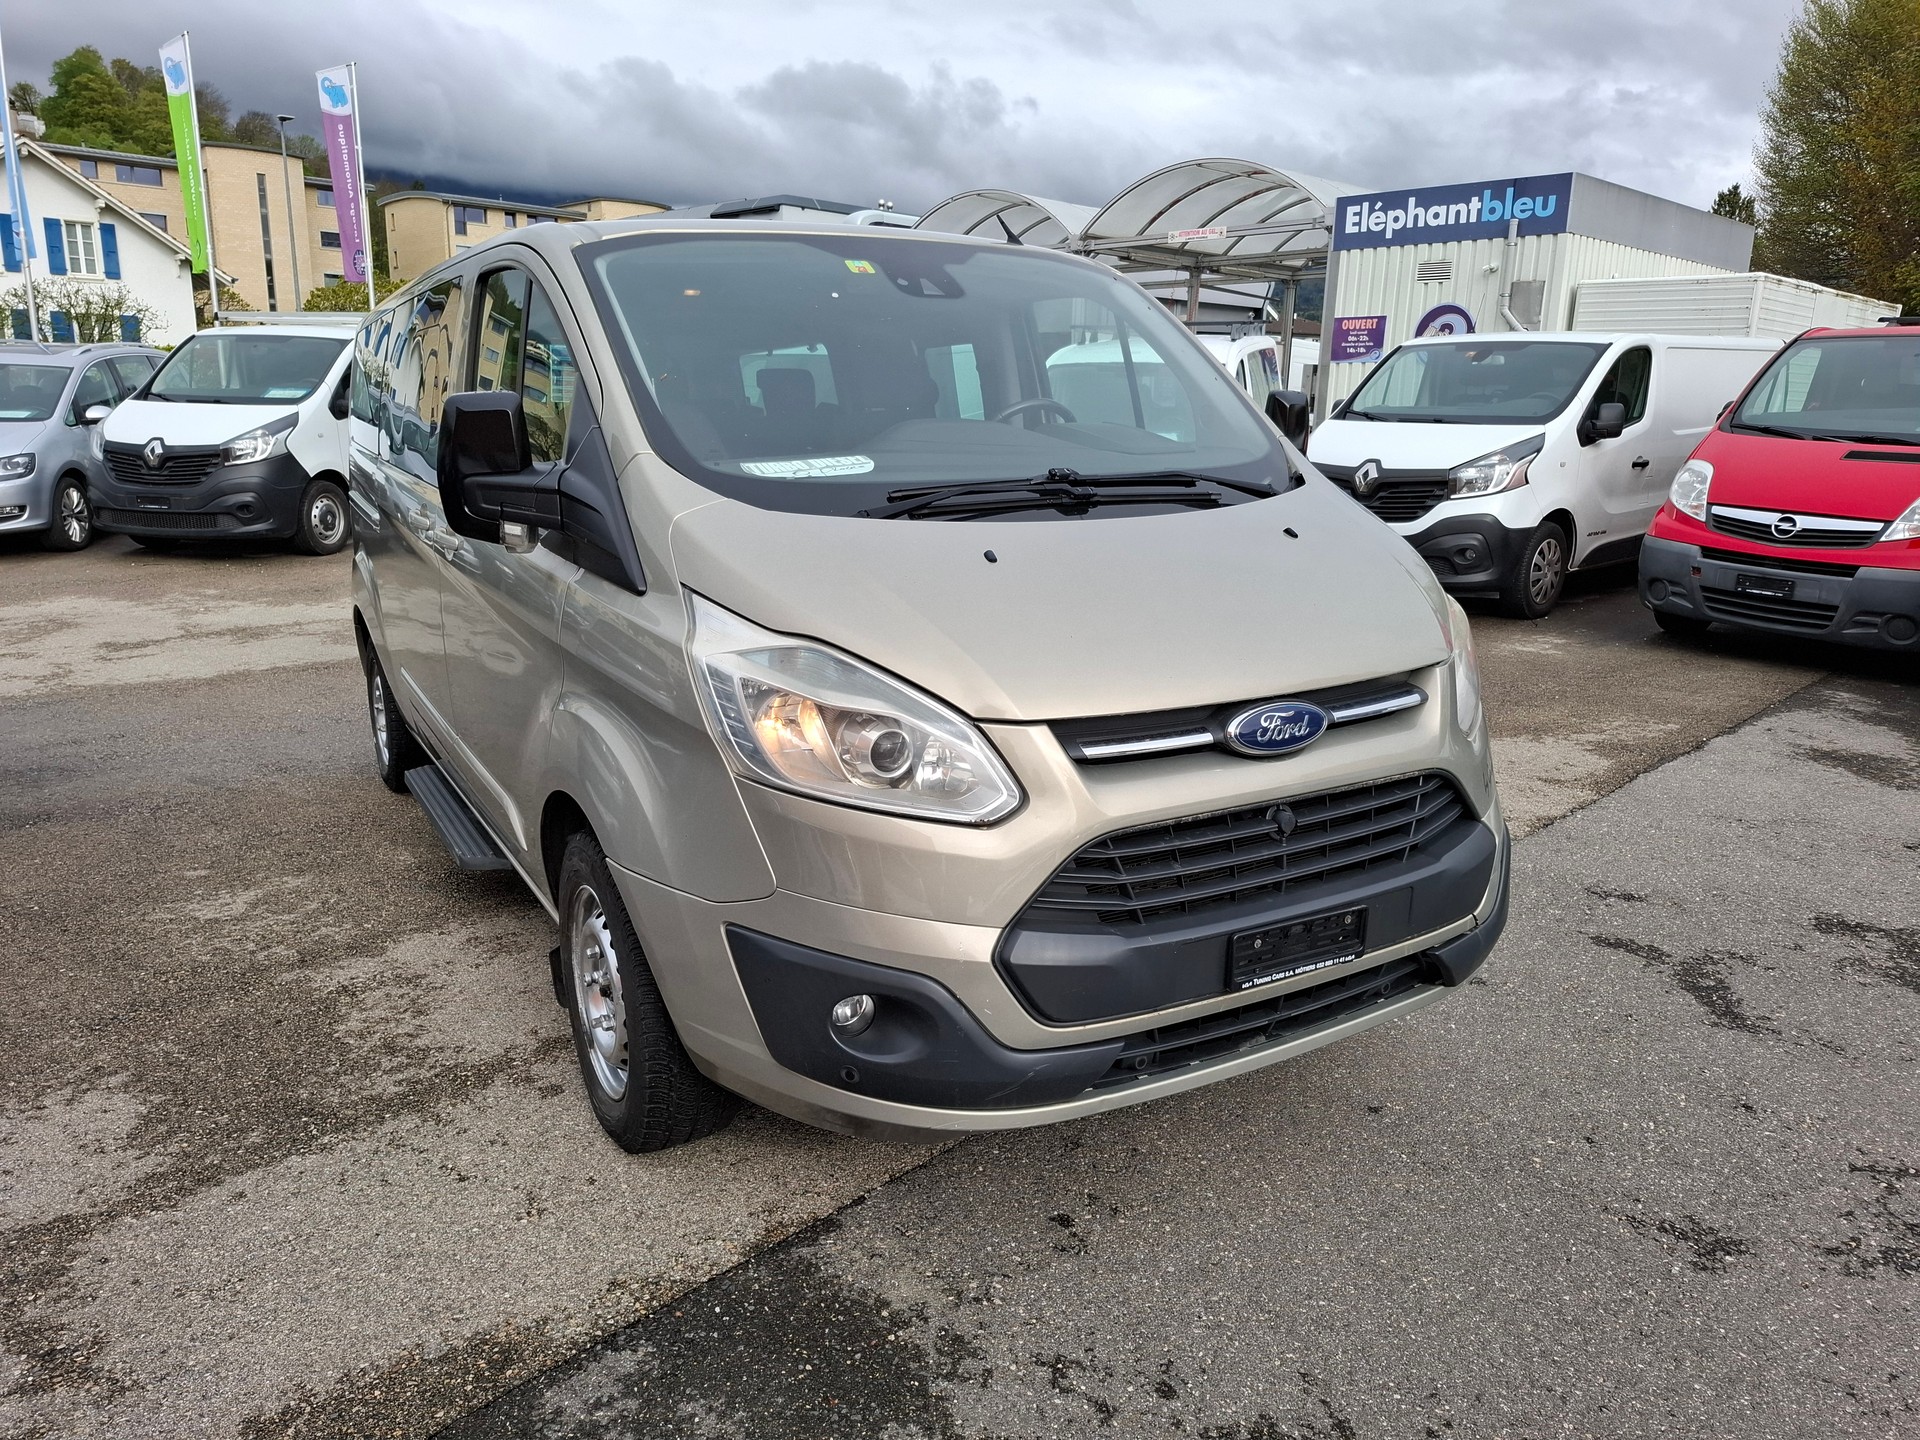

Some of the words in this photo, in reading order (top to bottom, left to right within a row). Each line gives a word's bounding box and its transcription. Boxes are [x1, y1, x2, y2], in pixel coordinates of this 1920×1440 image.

[1342, 319, 1378, 330] OUVERT
[744, 460, 810, 474] TURBO
[808, 455, 872, 468] DIESEL
[1257, 710, 1310, 744] Ford
